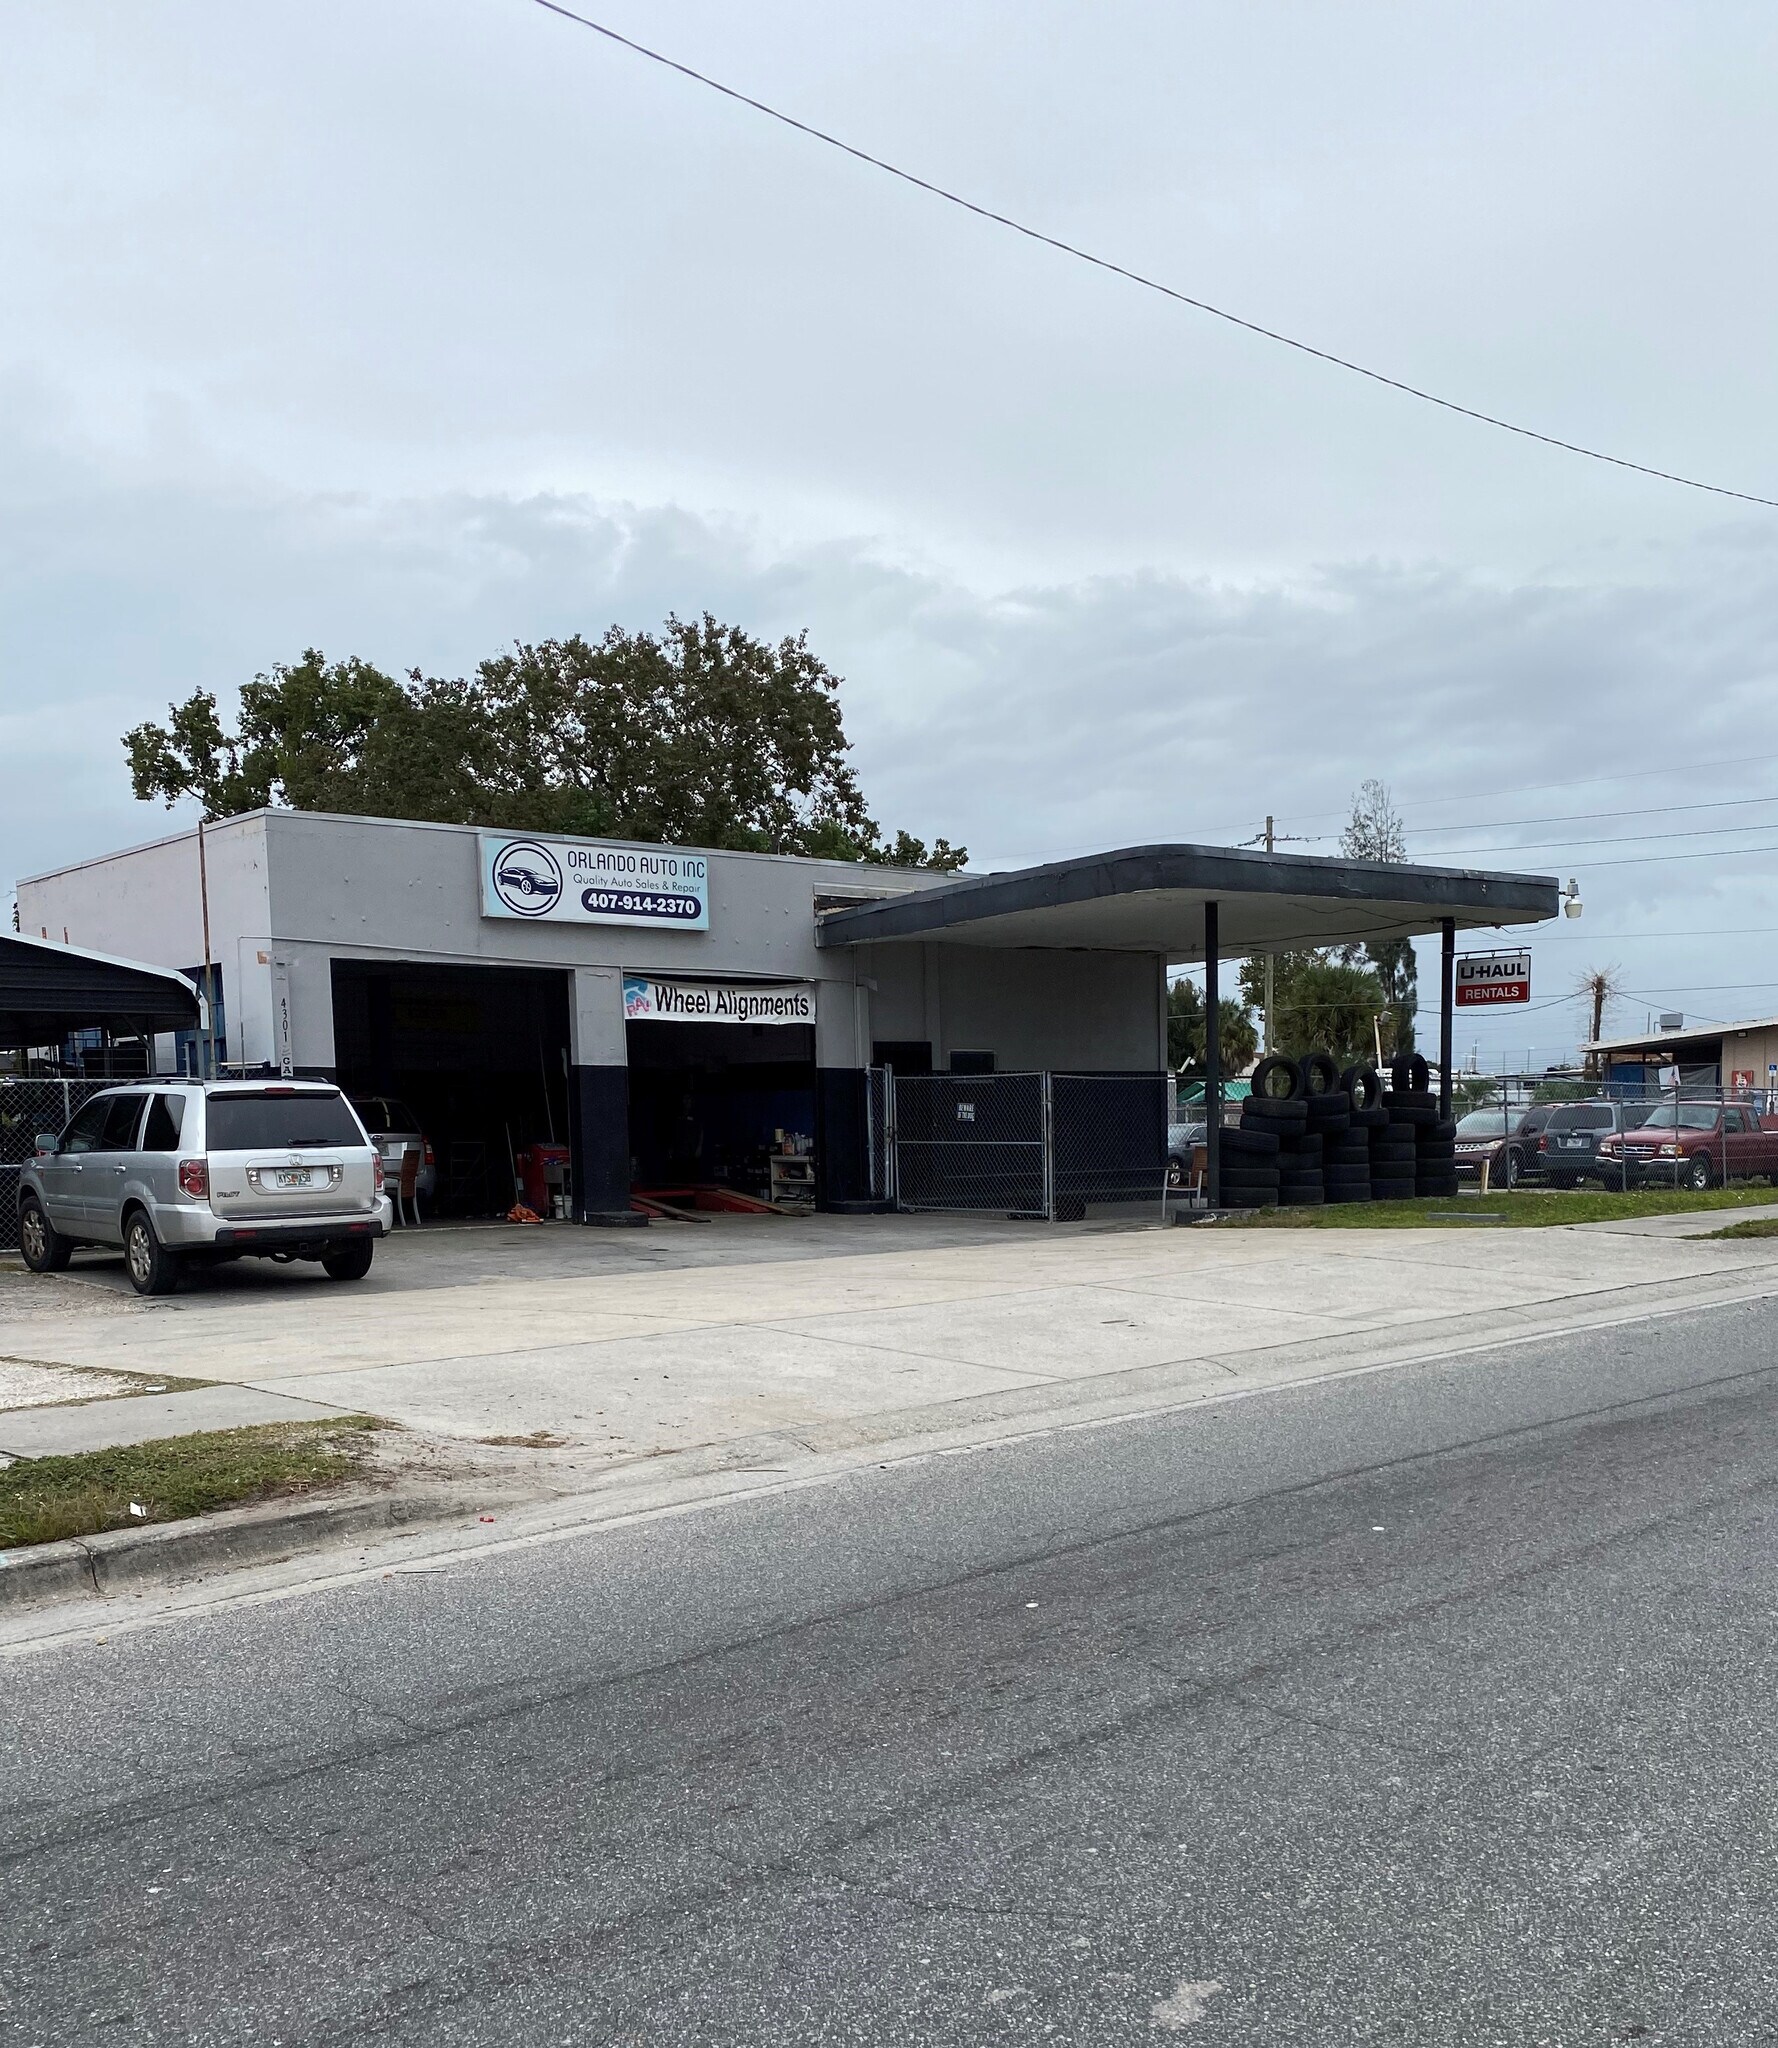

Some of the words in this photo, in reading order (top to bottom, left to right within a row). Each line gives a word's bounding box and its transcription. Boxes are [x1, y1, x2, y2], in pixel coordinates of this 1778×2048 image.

[568, 851, 635, 873] ORLANDO
[640, 857, 678, 876] AUTO
[683, 860, 705, 878] INC
[573, 873, 608, 888] Quality
[610, 877, 633, 888] Auto
[635, 878, 659, 890] Sales
[662, 881, 669, 890] &
[672, 881, 700, 894] Repair
[588, 893, 695, 914] 407-914-2370
[1460, 963, 1526, 979] U-HAUL
[655, 985, 710, 1014] Wheel
[714, 990, 809, 1021] Alignments
[1465, 986, 1519, 1000] RENTALS
[281, 998, 289, 1042] 4301
